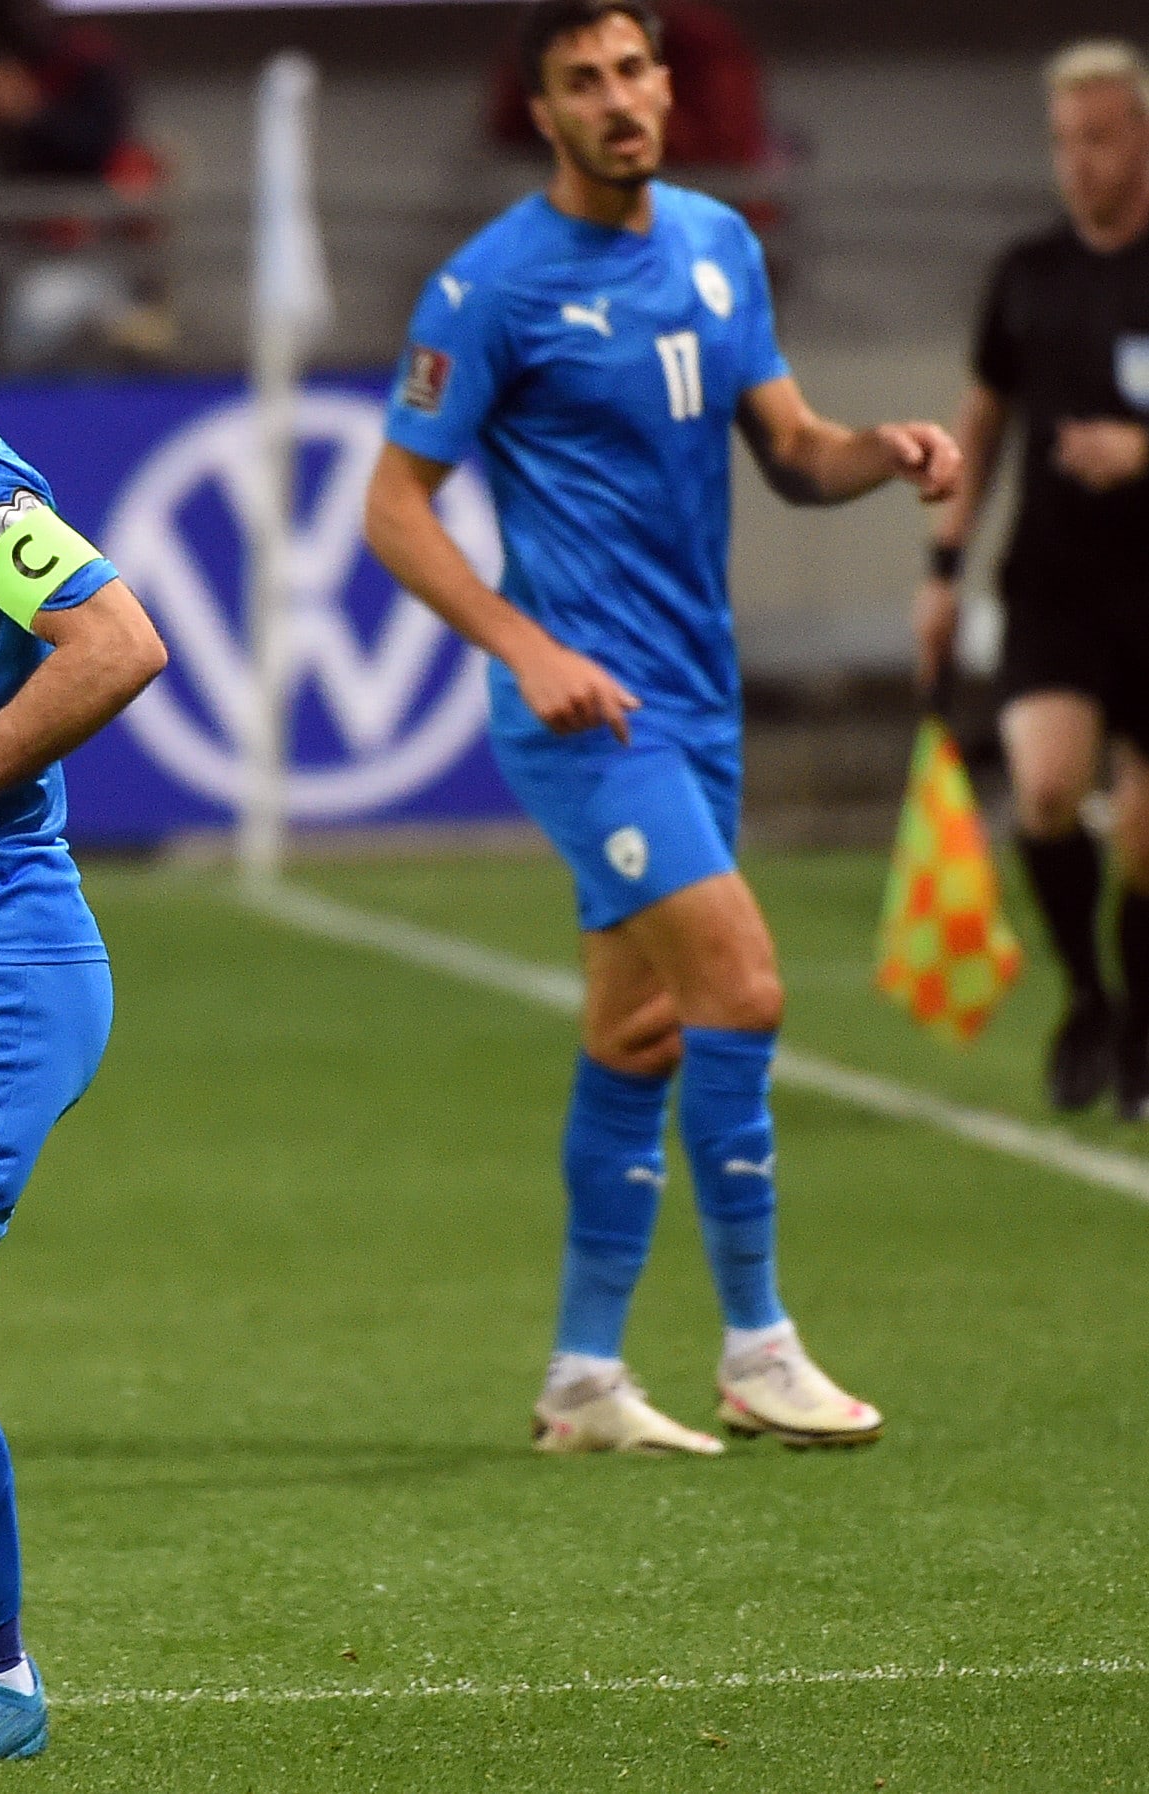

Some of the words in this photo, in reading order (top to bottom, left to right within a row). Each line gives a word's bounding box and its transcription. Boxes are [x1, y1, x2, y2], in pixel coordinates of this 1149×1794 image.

[655, 330, 704, 422] 11
[12, 533, 60, 579] C
[114, 402, 502, 790] VW
